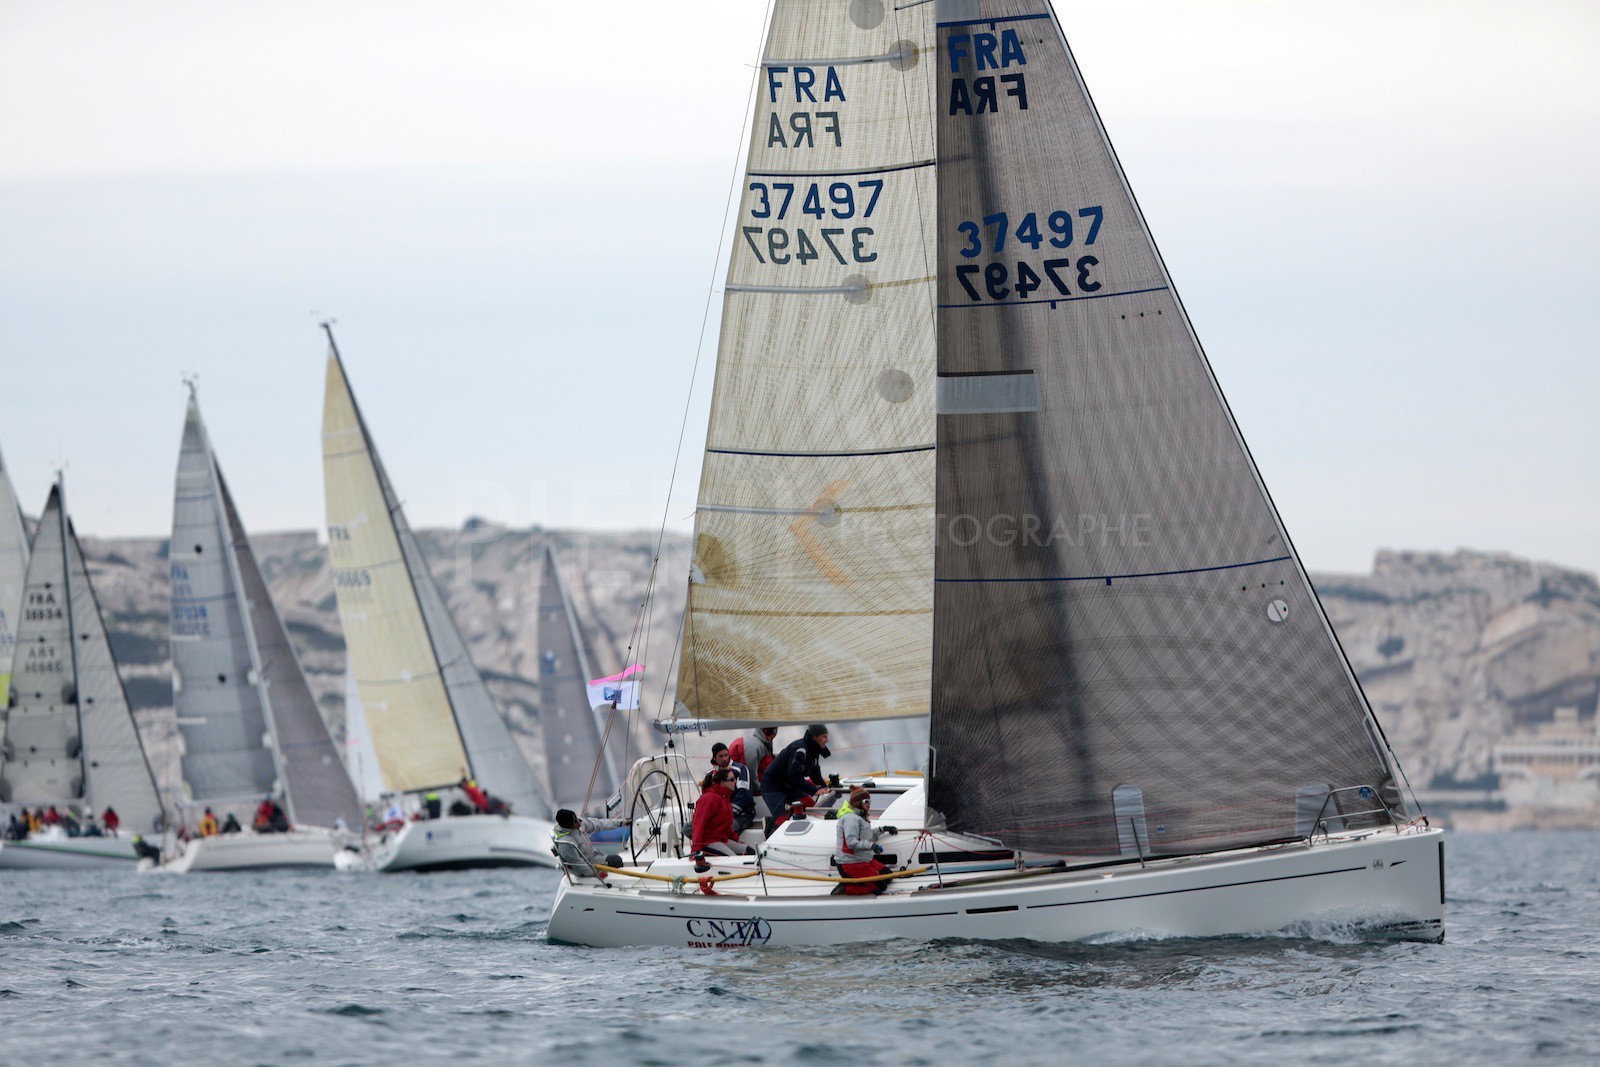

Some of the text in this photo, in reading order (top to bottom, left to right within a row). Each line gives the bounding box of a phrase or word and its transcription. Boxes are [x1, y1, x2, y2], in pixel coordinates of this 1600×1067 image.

[947, 28, 1027, 73] FRA
[767, 65, 846, 104] FRA
[749, 178, 884, 221] 37497
[957, 205, 1104, 260] 37497
